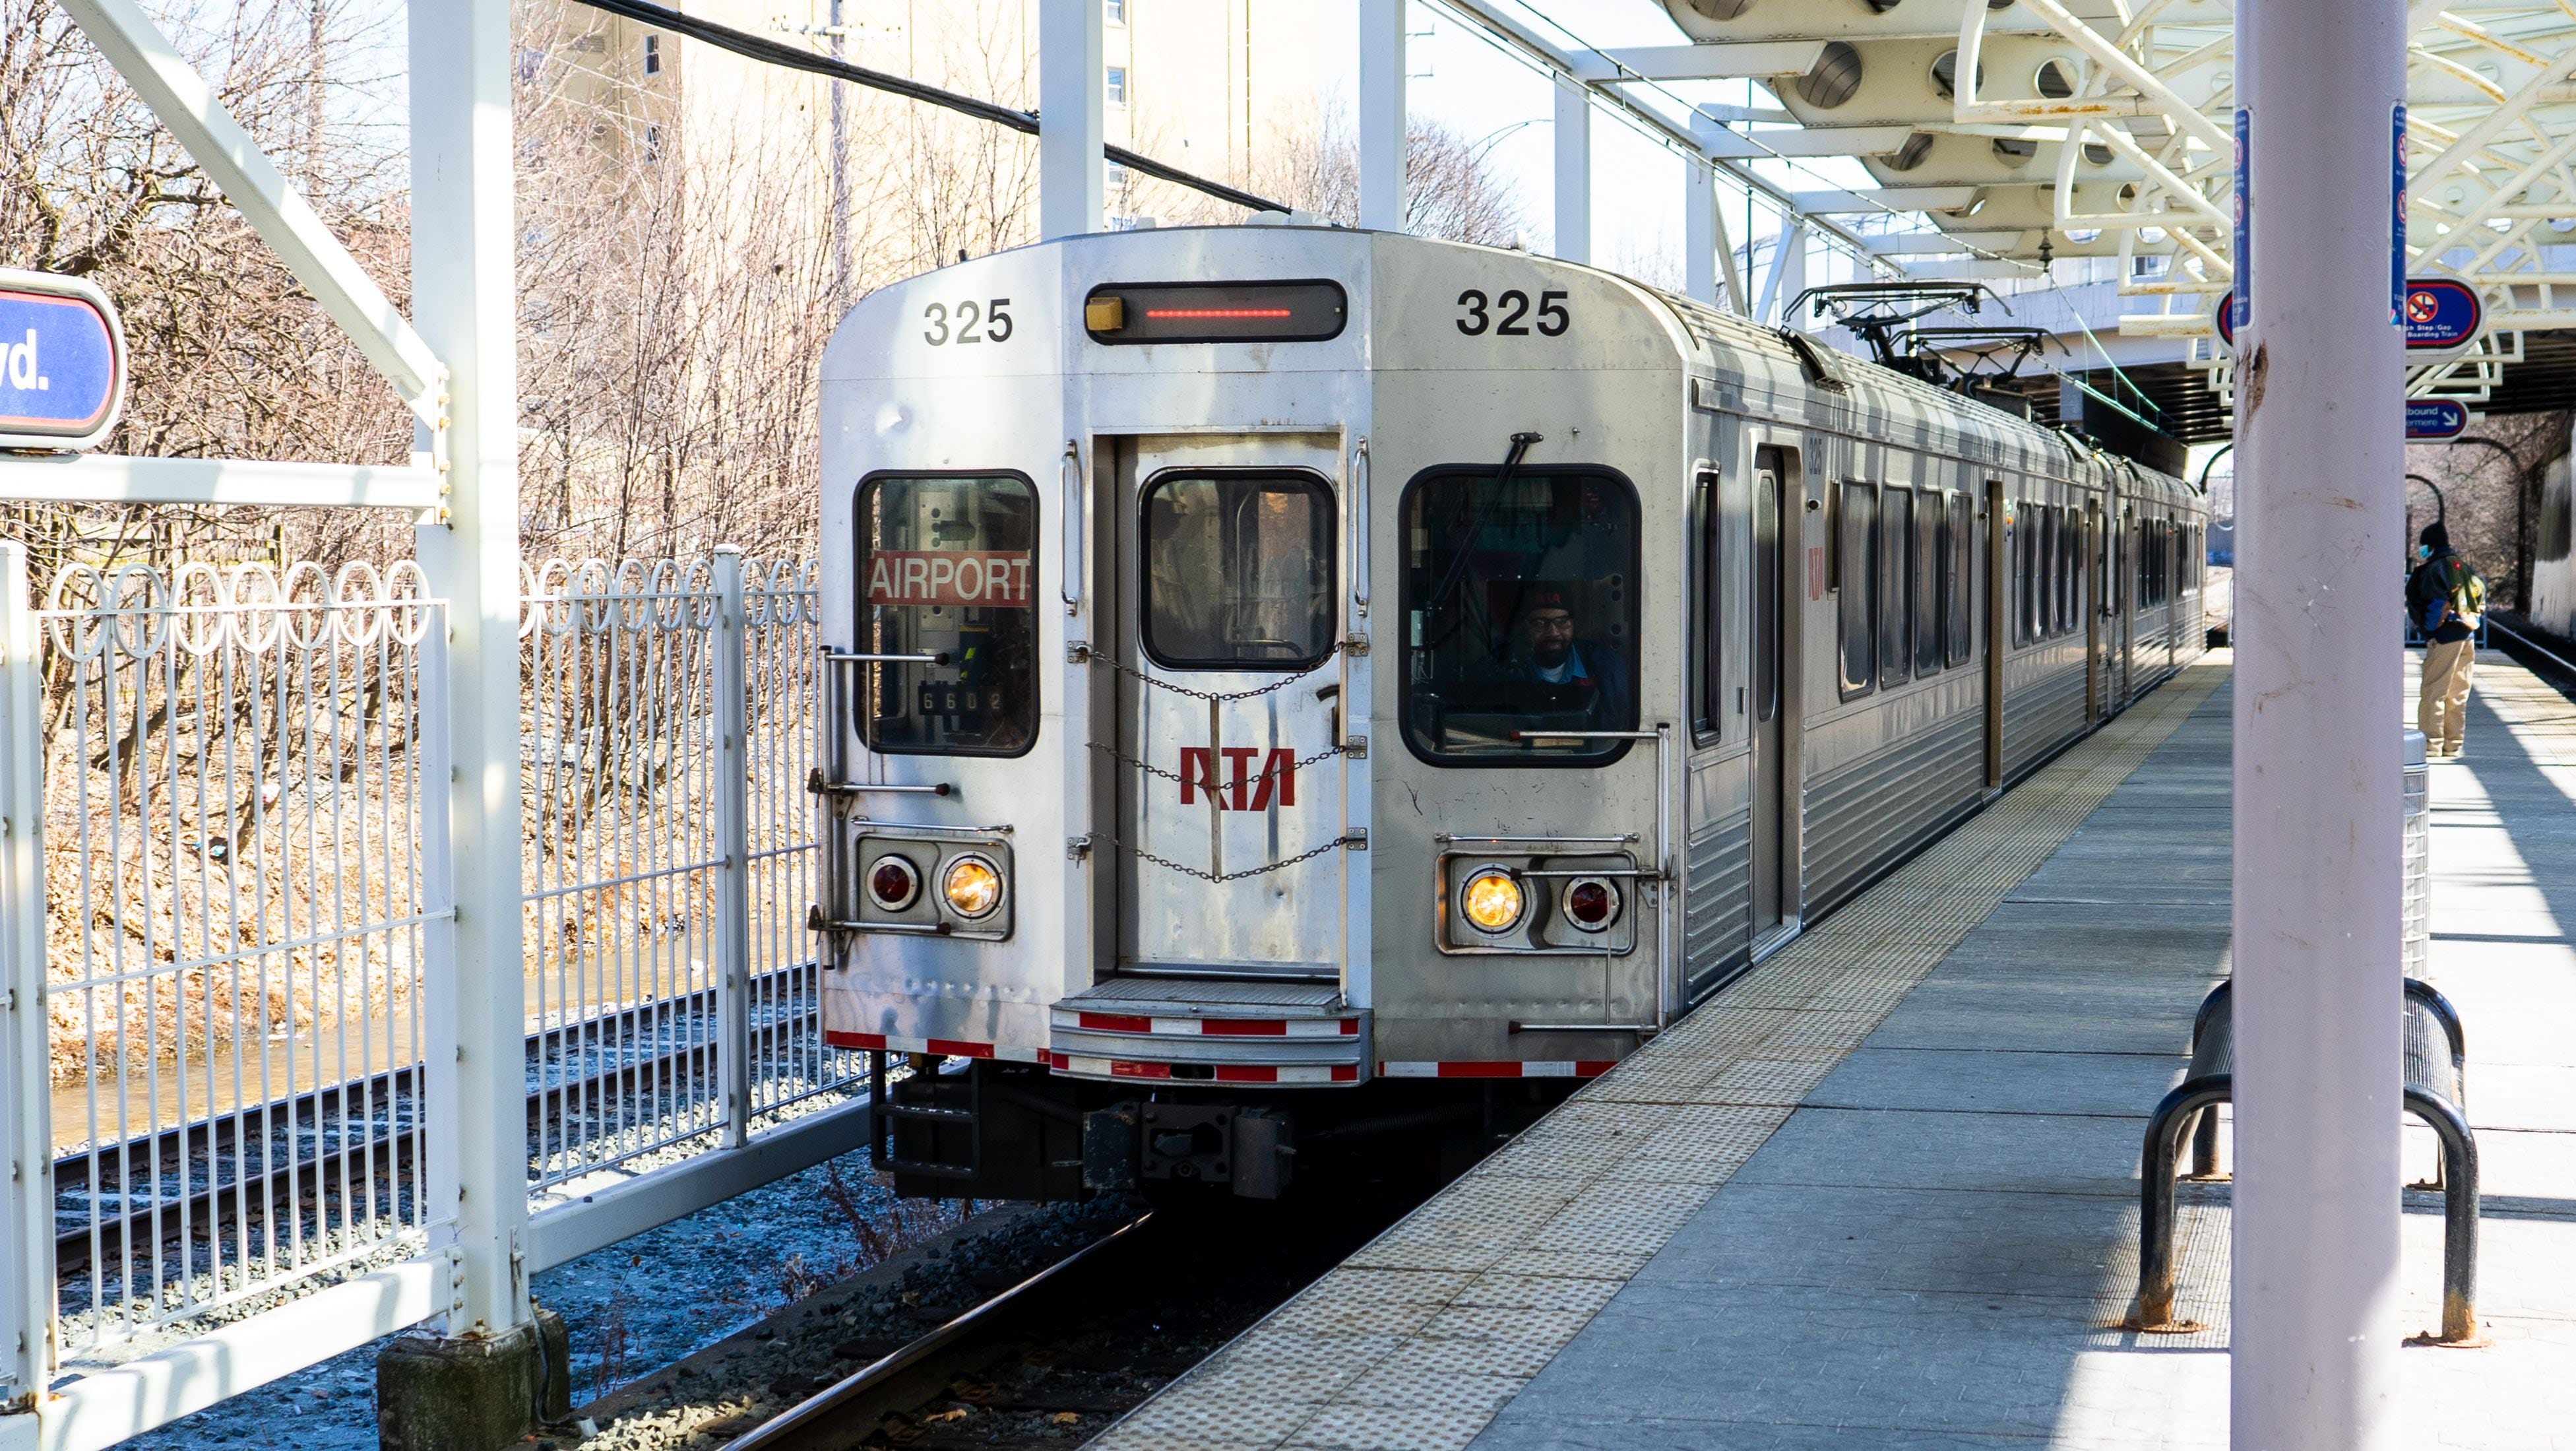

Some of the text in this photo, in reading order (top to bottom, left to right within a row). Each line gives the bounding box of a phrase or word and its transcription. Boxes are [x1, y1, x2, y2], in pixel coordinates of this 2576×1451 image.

[924, 298, 1013, 346] 325
[1456, 289, 1570, 337] 325
[2406, 406, 2438, 416] bound
[1809, 436, 1822, 476] 325
[867, 557, 1031, 600] AIRPORT
[1180, 746, 1295, 812] RTA
